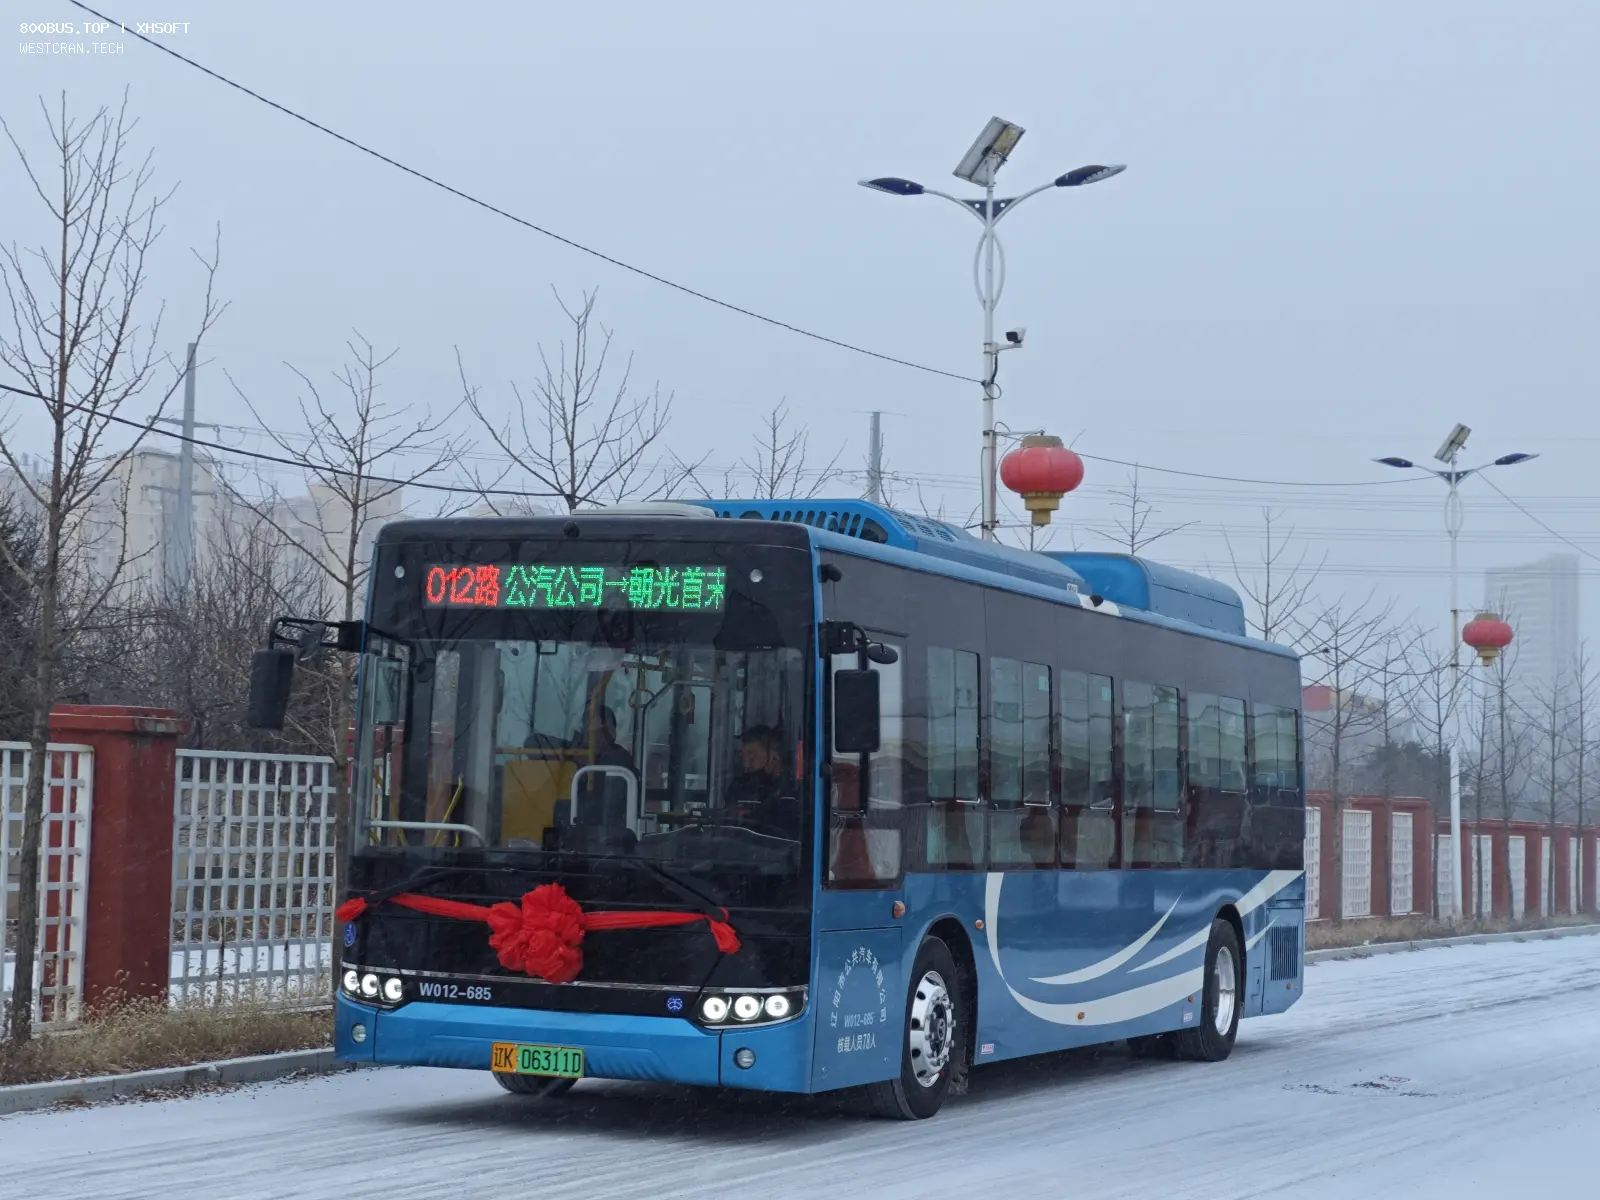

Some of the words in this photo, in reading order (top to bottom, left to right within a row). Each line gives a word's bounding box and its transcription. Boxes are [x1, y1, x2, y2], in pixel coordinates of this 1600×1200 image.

[426, 565, 500, 606] 012路
[419, 982, 492, 1001] W012-685
[844, 1012, 875, 1028] W012-685
